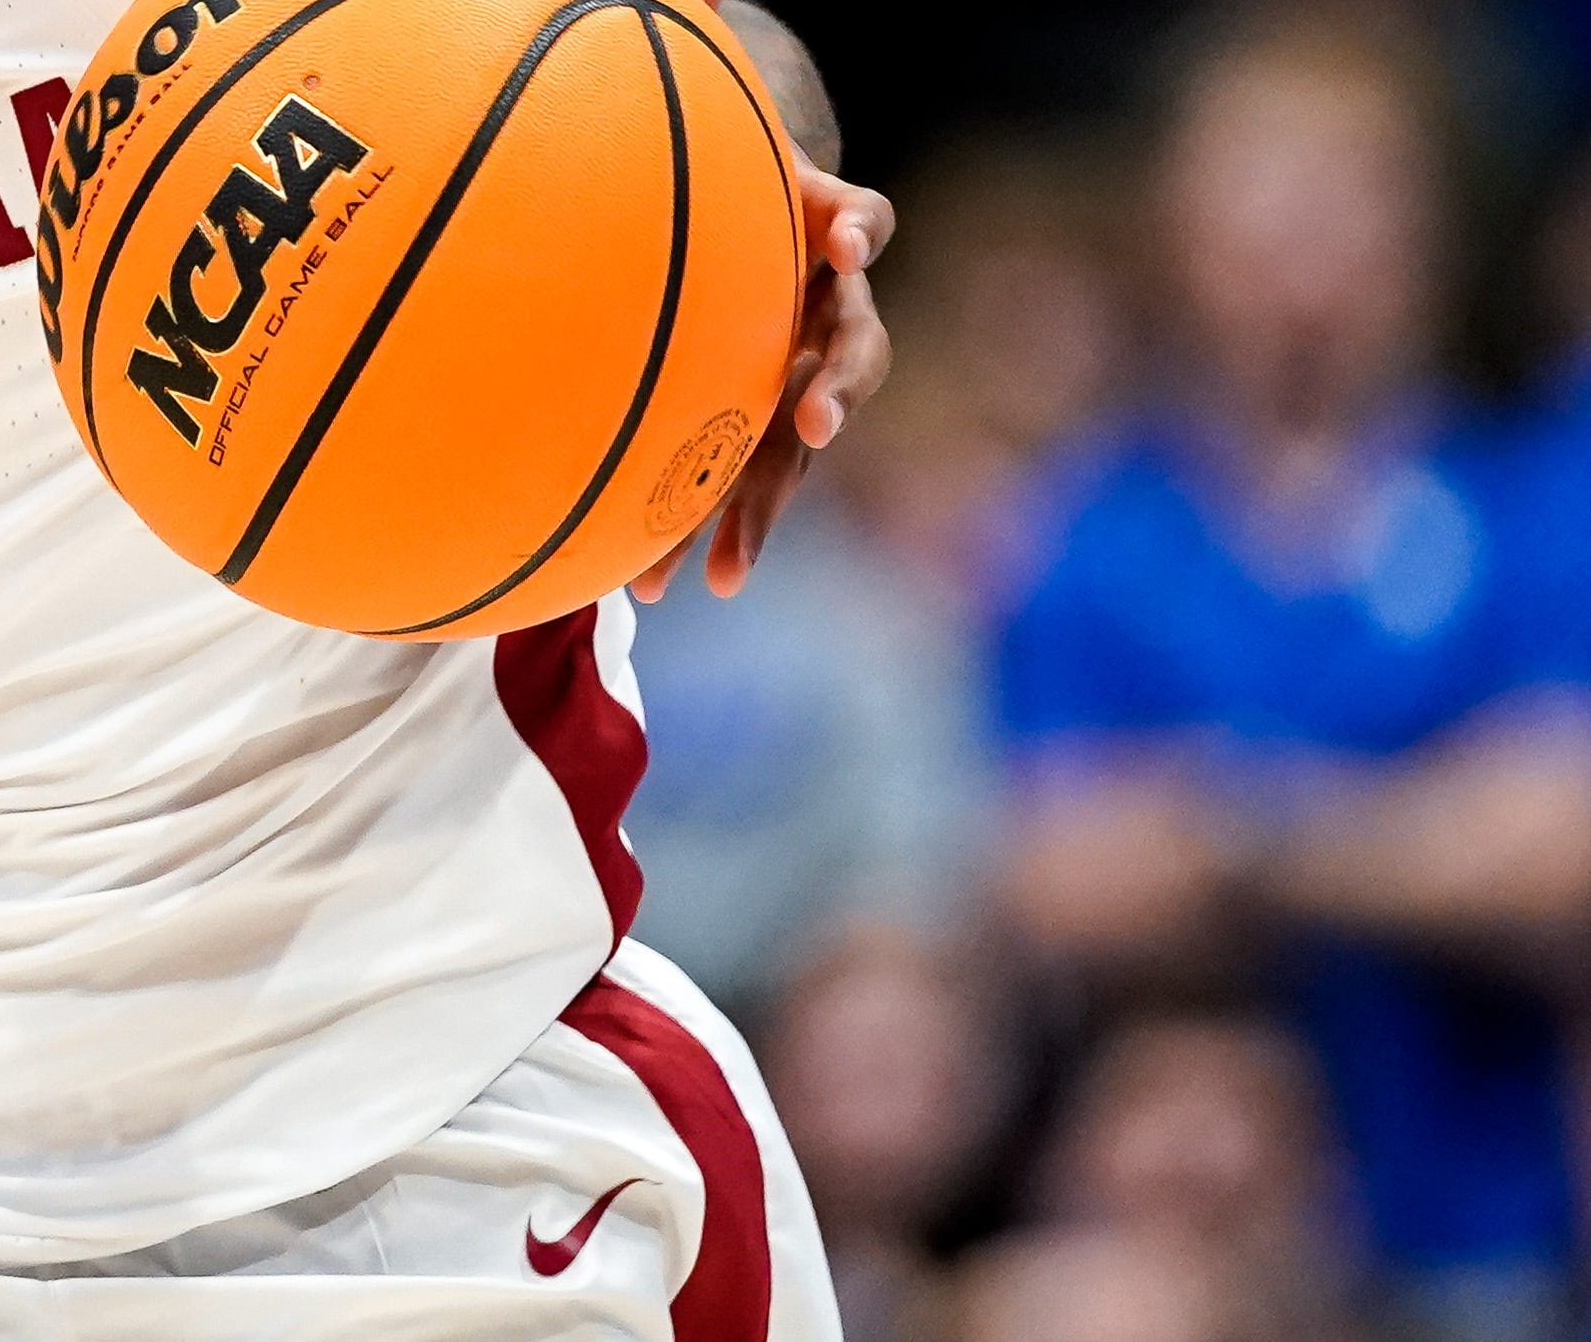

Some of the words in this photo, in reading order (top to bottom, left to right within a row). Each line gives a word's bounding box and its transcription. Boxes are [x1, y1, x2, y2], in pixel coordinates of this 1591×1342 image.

[124, 92, 375, 451] NCAA
[208, 345, 271, 468] OFFICIAL
[264, 243, 329, 339] GAME
[323, 164, 395, 243] BALL
